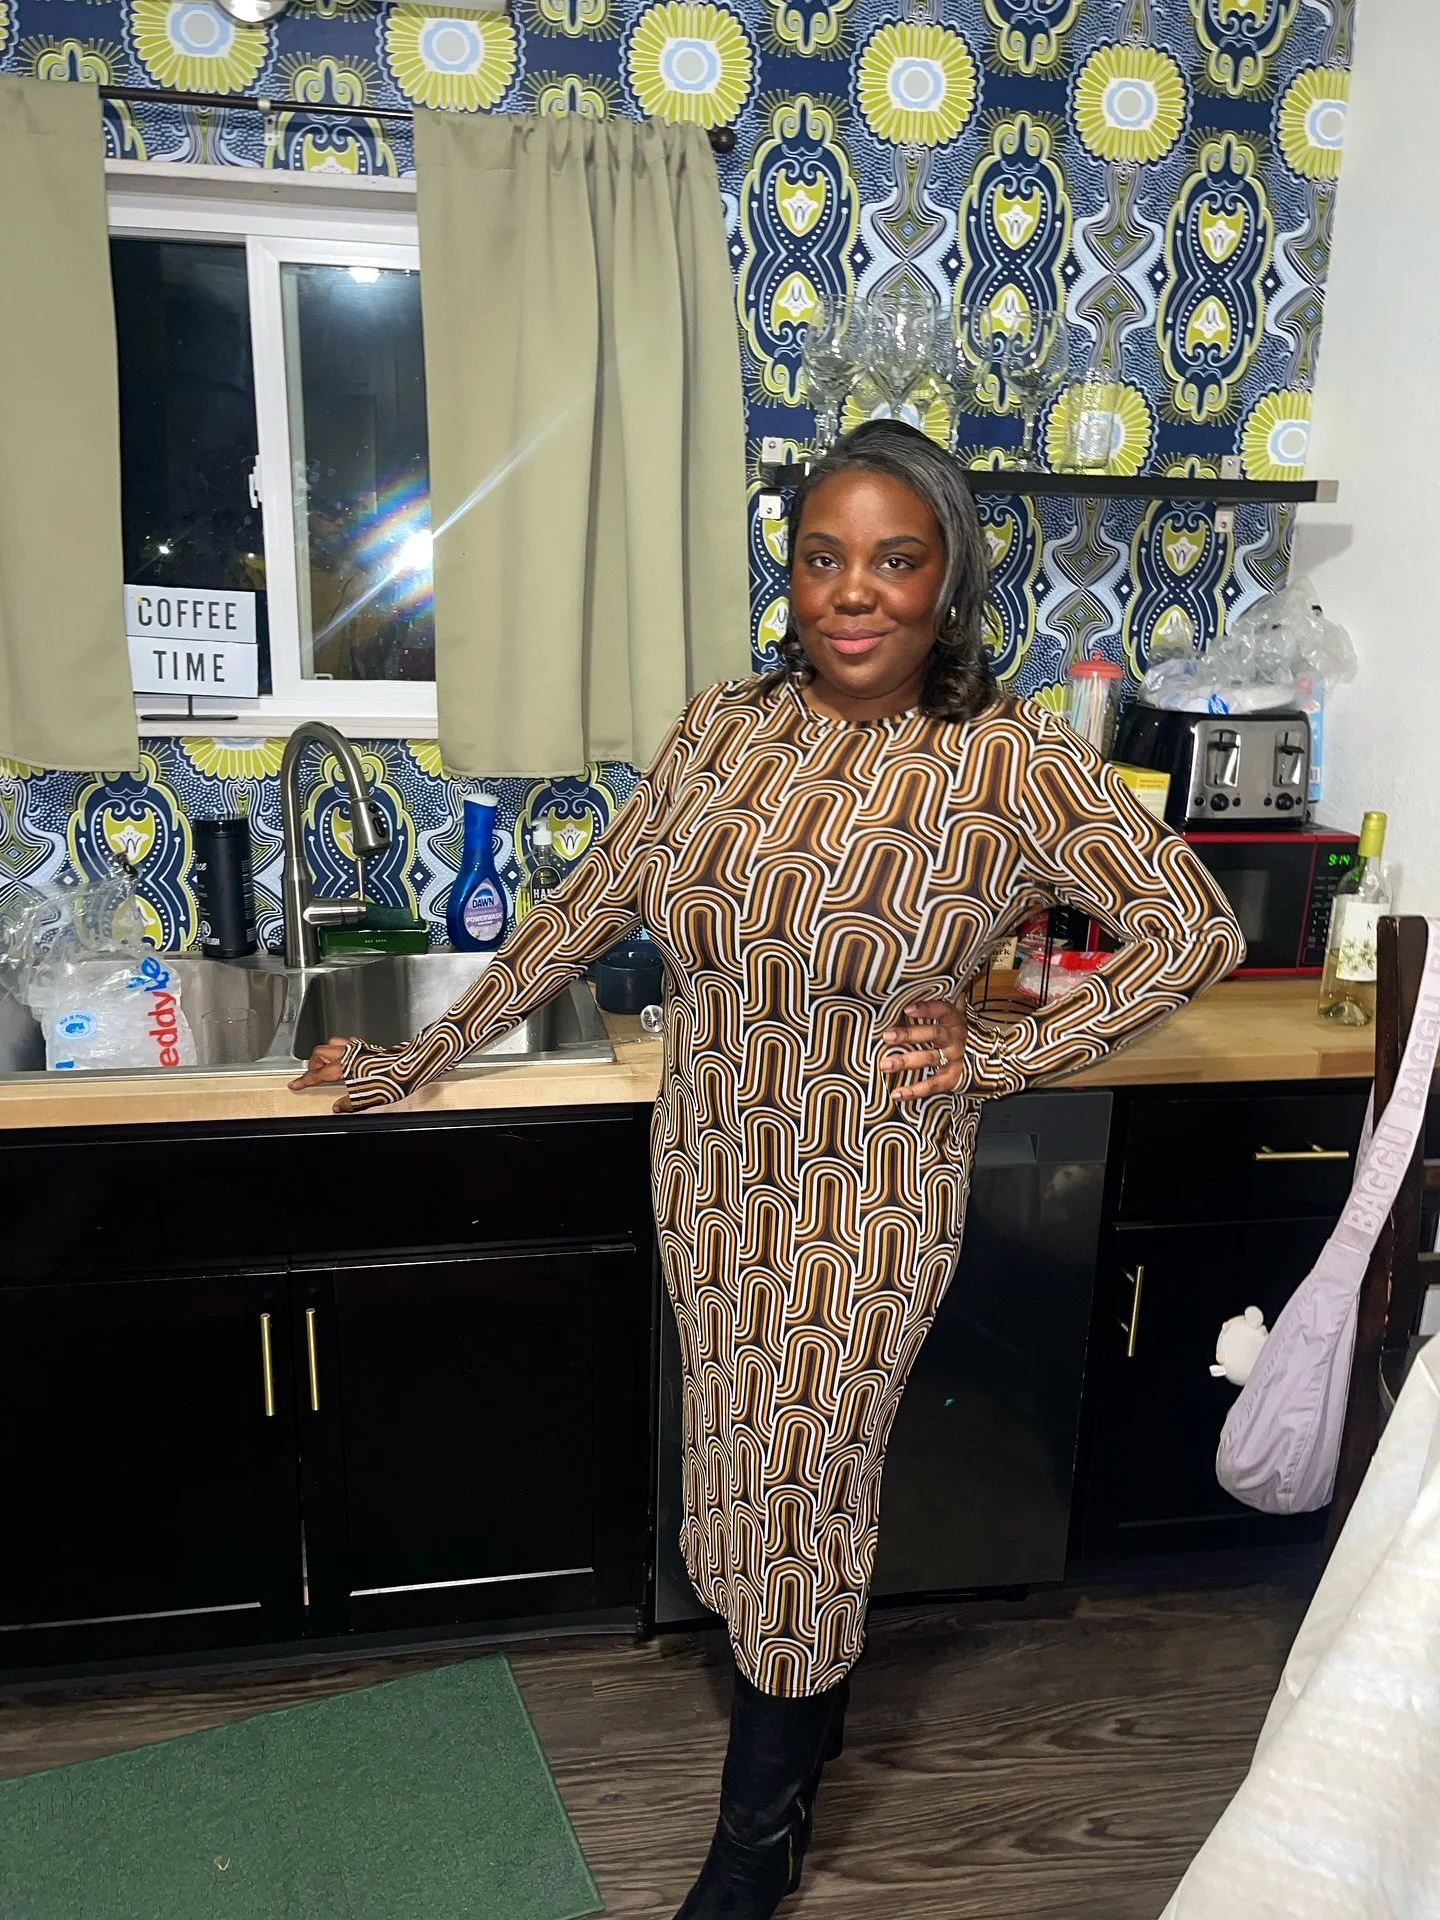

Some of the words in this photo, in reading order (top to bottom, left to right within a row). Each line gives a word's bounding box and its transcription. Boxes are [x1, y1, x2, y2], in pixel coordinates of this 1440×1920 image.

[138, 597, 237, 630] COFFEE
[153, 650, 225, 682] TIME
[472, 897, 495, 909] DAWN
[147, 991, 180, 1068] eddy
[1394, 994, 1440, 1111] BAGGU
[1343, 1122, 1413, 1237] BAGGU
